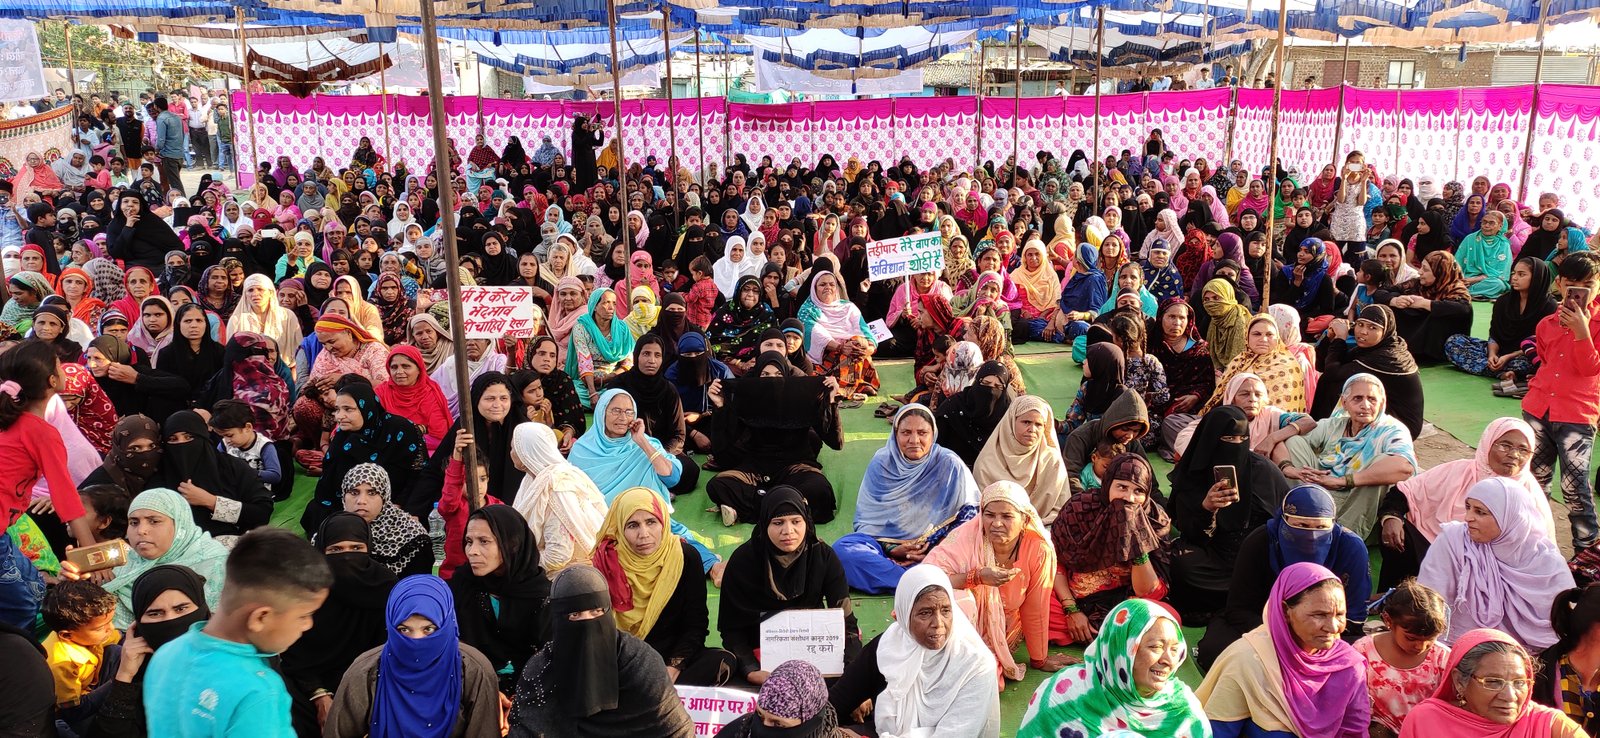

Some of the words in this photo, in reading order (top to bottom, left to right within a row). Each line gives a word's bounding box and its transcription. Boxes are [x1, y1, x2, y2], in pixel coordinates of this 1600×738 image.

[868, 241, 898, 258] तड़ीपार
[900, 237, 914, 251] तेरे
[915, 238, 931, 249] बाप
[930, 235, 942, 246] का
[870, 259, 906, 276] संविधान
[908, 251, 932, 271] थोड़ी
[932, 249, 942, 269] है
[461, 287, 476, 303] र्म
[510, 288, 530, 302] जो
[469, 304, 517, 319] भेदभाव
[509, 317, 530, 329] ऐसा
[765, 634, 790, 642] नागरिकता
[790, 634, 810, 642] संशोधन
[810, 635, 825, 643] कानून
[818, 641, 834, 653] करो
[688, 697, 725, 712] आधार
[727, 700, 744, 714] पर
